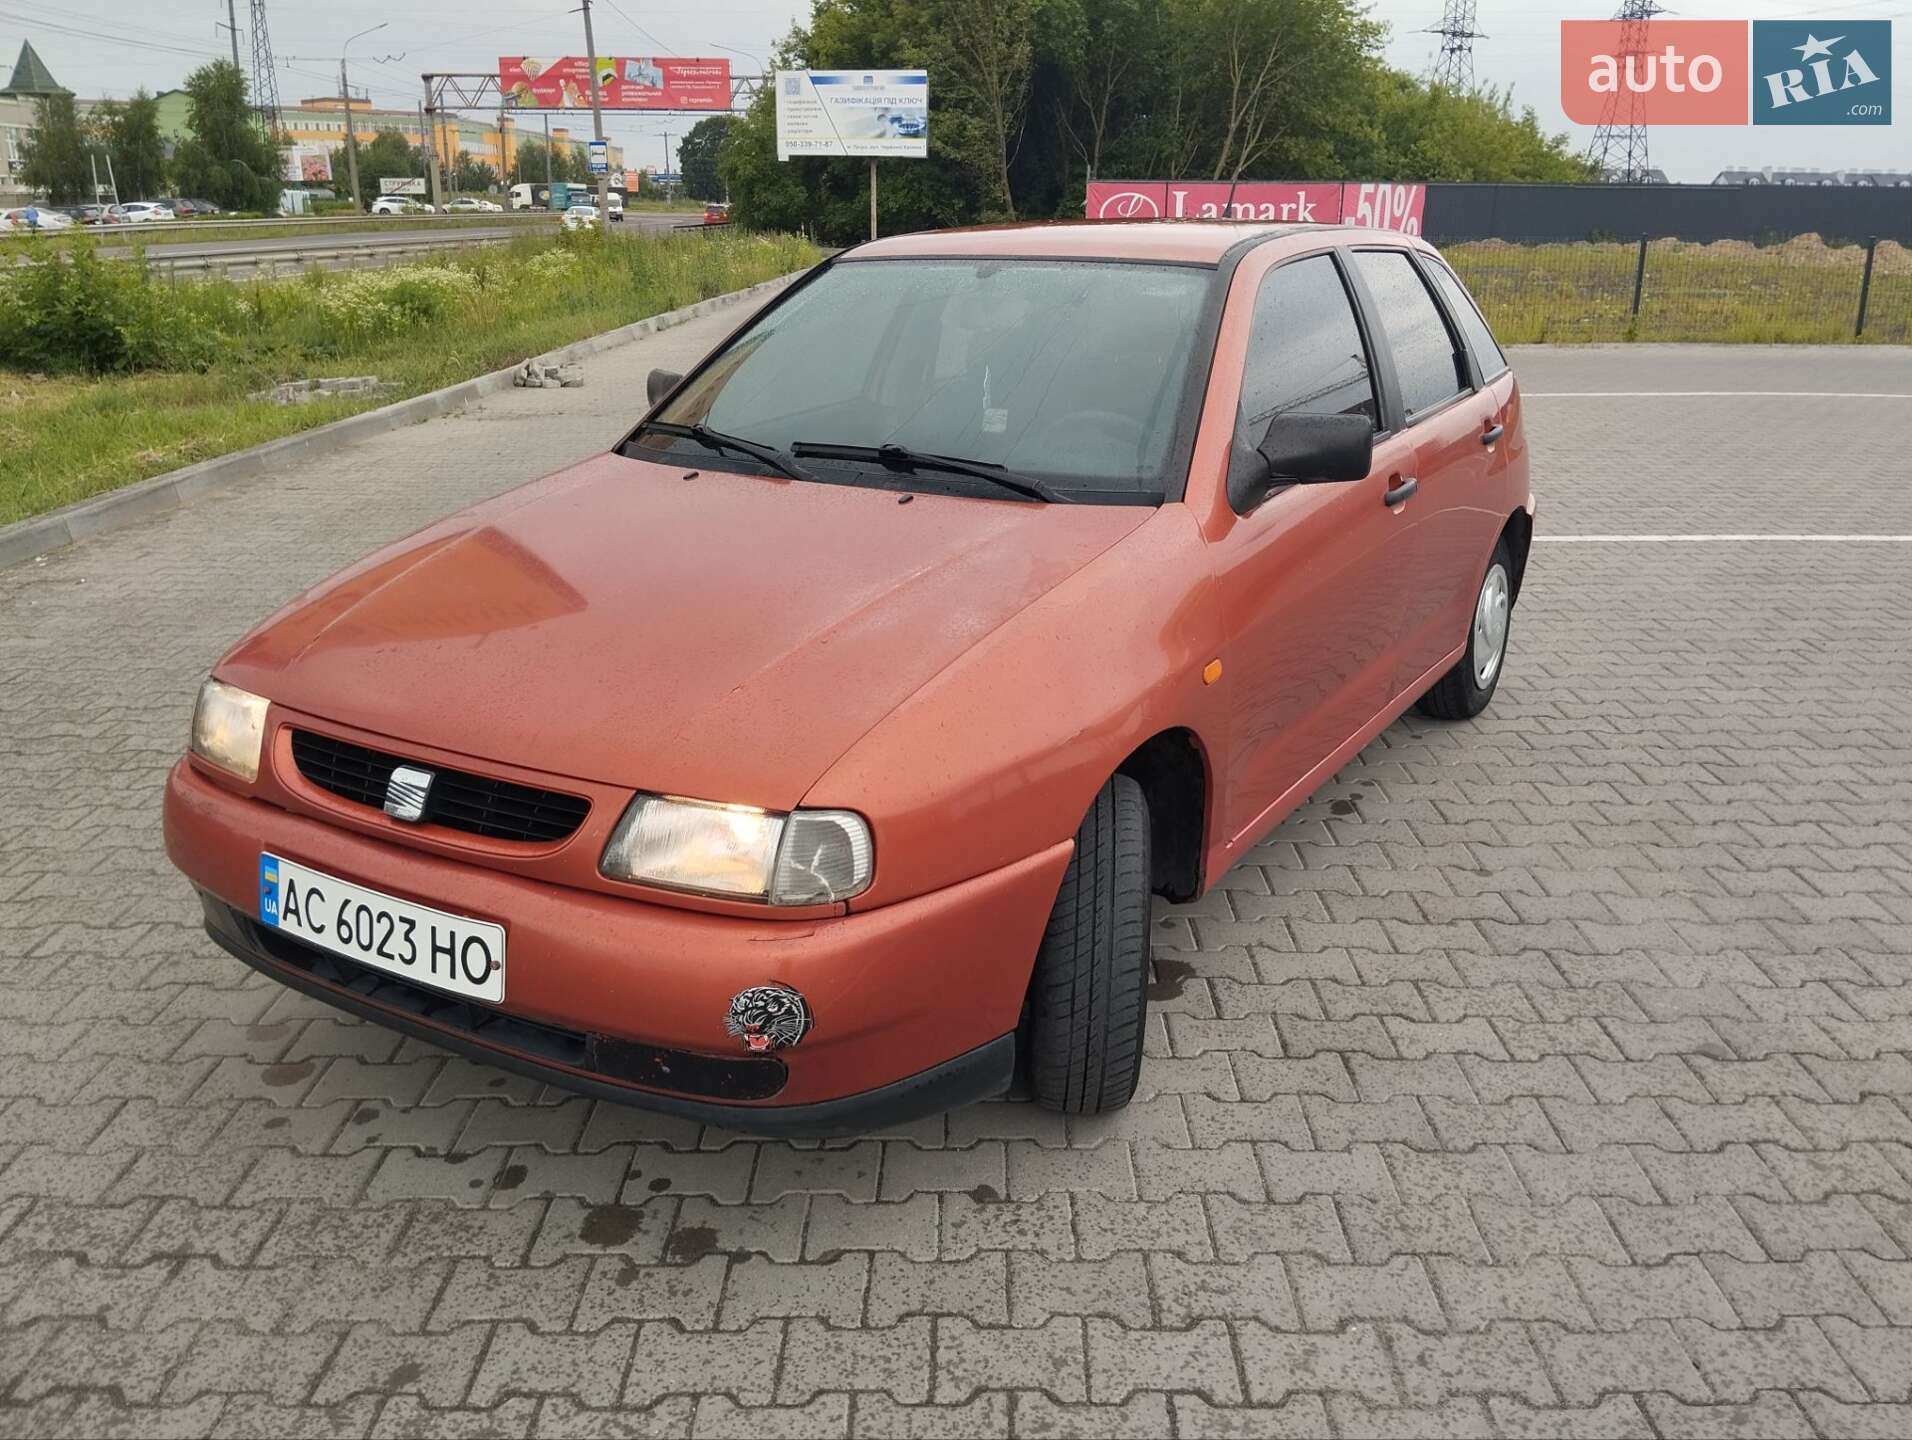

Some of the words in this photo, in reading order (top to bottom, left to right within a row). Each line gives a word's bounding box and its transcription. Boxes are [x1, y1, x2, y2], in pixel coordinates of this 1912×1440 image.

[1172, 190, 1317, 222] Lamark
[264, 897, 278, 917] UA
[282, 877, 326, 935] AC
[336, 898, 417, 966] 6023
[430, 925, 492, 986] HO
